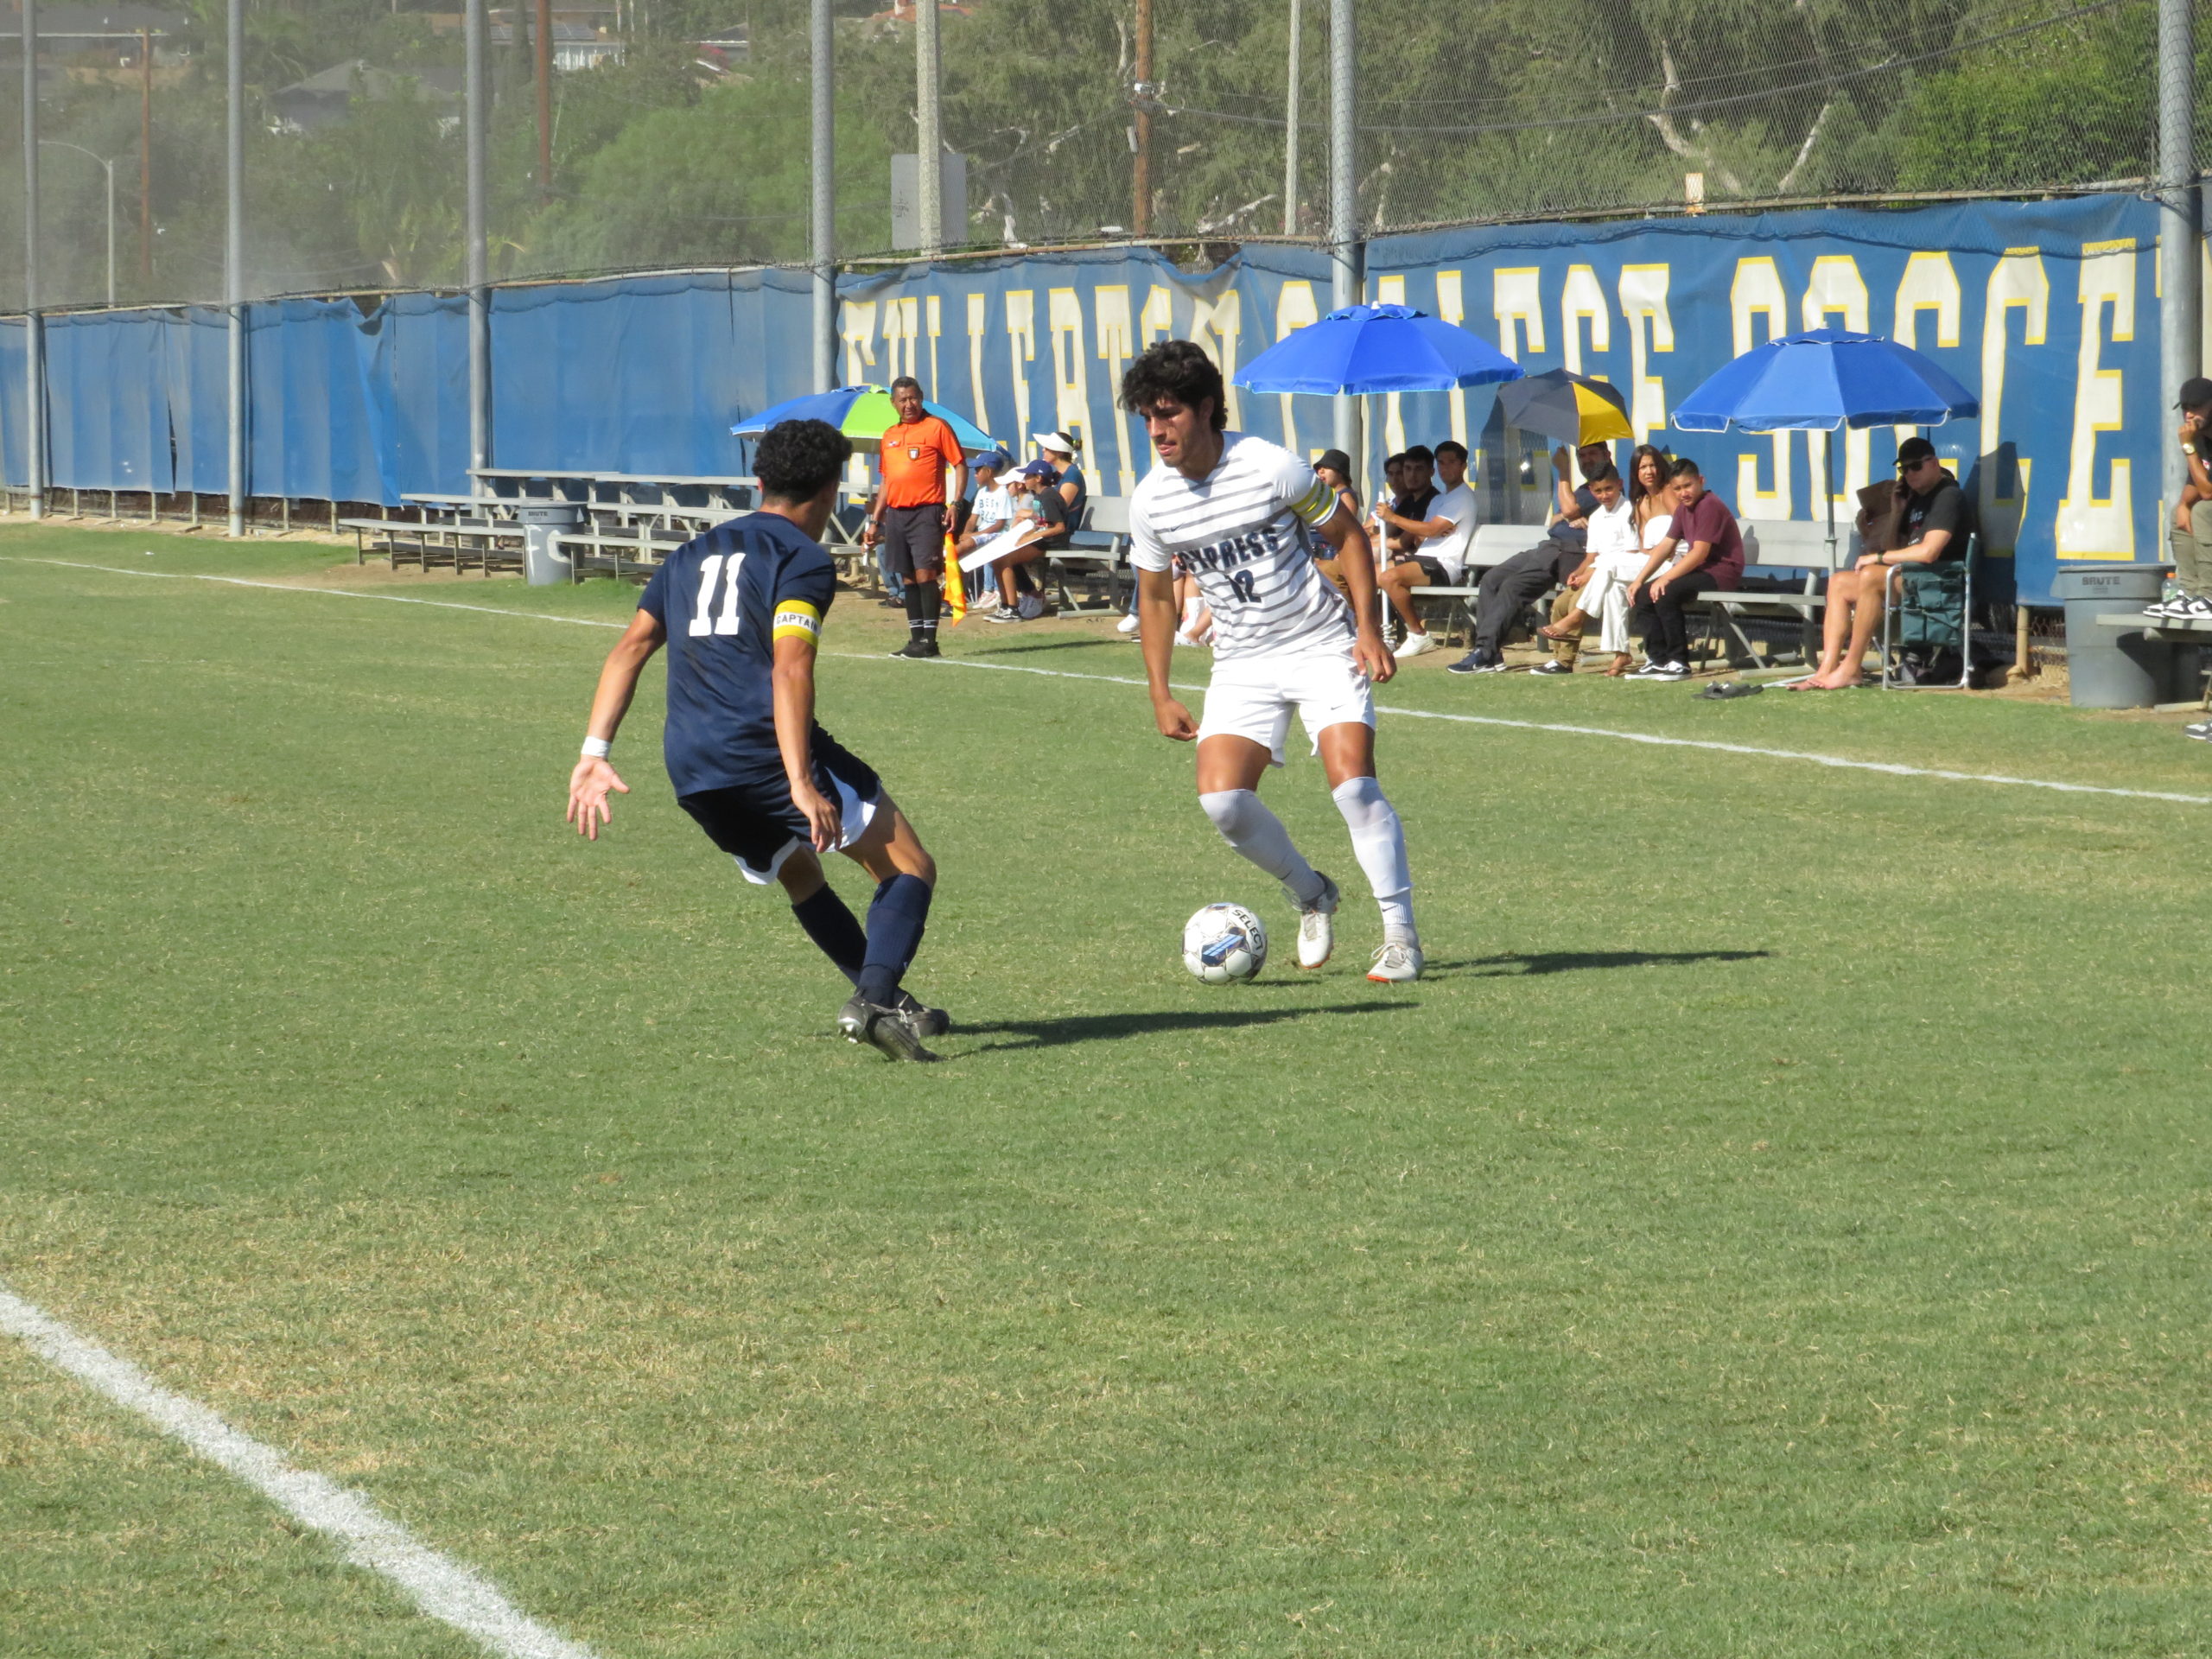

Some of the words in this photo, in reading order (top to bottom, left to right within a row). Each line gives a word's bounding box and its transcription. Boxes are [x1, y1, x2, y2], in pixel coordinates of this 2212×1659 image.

[1730, 237, 2212, 562] SOCCE
[689, 552, 746, 637] 11
[1224, 569, 1262, 603] 12
[2082, 576, 2120, 585] BRUTE
[1232, 909, 1263, 950] SELECT
